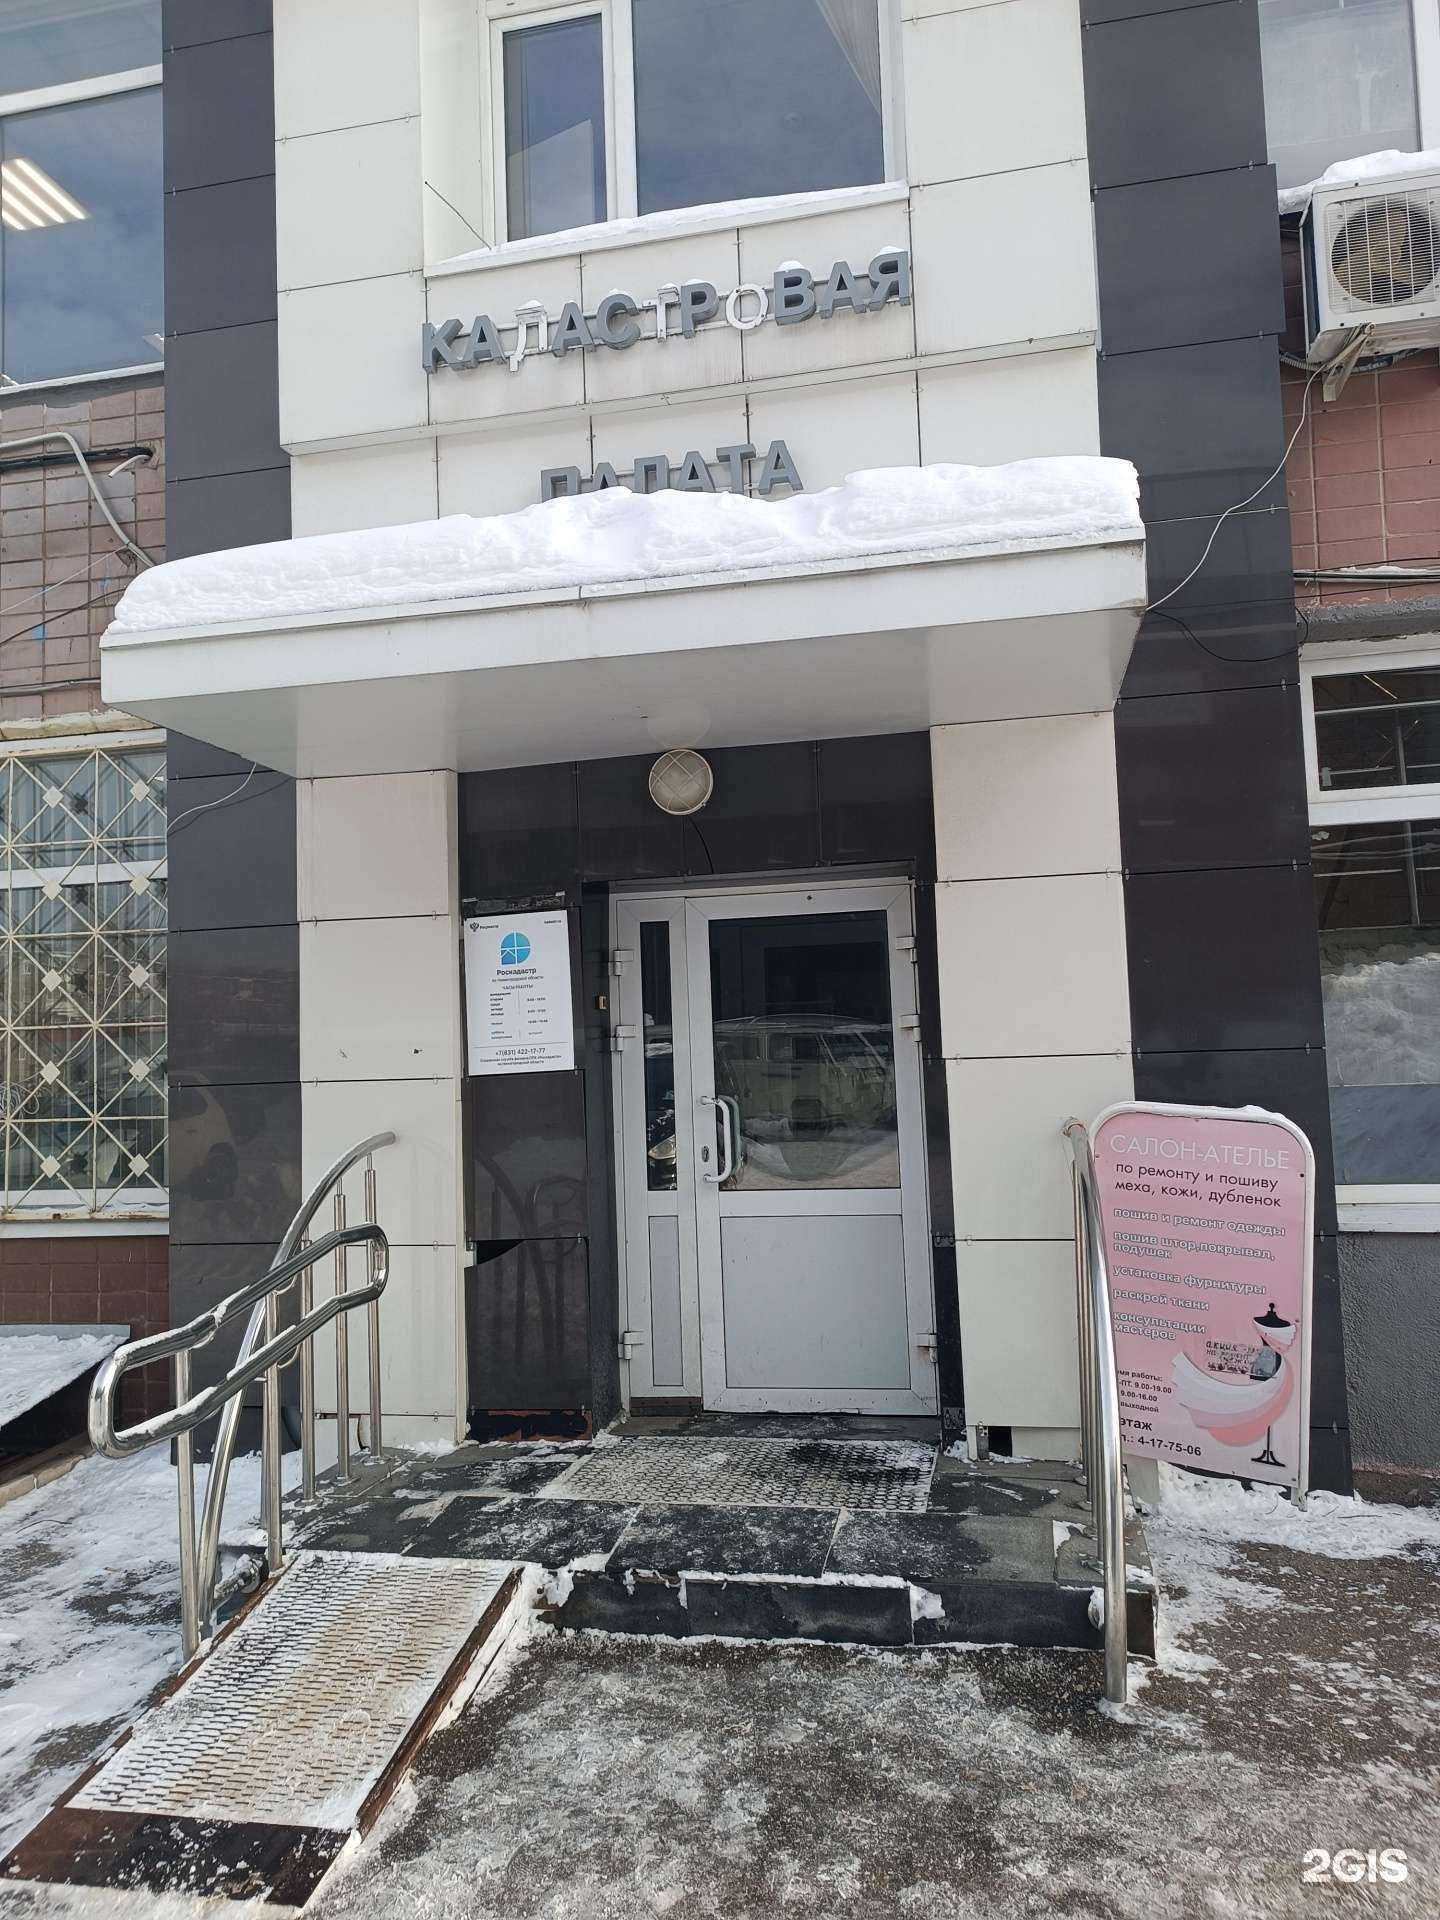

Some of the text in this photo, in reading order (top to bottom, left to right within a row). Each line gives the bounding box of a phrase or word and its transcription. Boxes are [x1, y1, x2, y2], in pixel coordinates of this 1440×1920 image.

[421, 250, 910, 373] КАДАСТРОВАЯ
[1110, 1134, 1290, 1169] САЛОН-АТЕЛЬЕ
[1116, 1164, 1279, 1193] по ремонту и пошиву
[1115, 1182, 1282, 1207] меха, кожи, дубленок
[1113, 1208, 1285, 1237] пошив и ремонт одежды
[1113, 1231, 1158, 1246] пошив
[1113, 1243, 1172, 1259] подушек
[1113, 1265, 1267, 1295] установка фурнитуры
[1113, 1289, 1210, 1311] раскрой ткани
[1113, 1312, 1207, 1334] консультации
[1114, 1323, 1177, 1341] мастеров
[1131, 1372, 1163, 1381] работы:
[1120, 1390, 1158, 1402] 9.00-16.00
[1134, 1381, 1172, 1394] 9.00-19.00
[1120, 1401, 1160, 1413] выходной
[1120, 1417, 1153, 1431] этаж
[1138, 1436, 1202, 1456] 4-17-75-06
